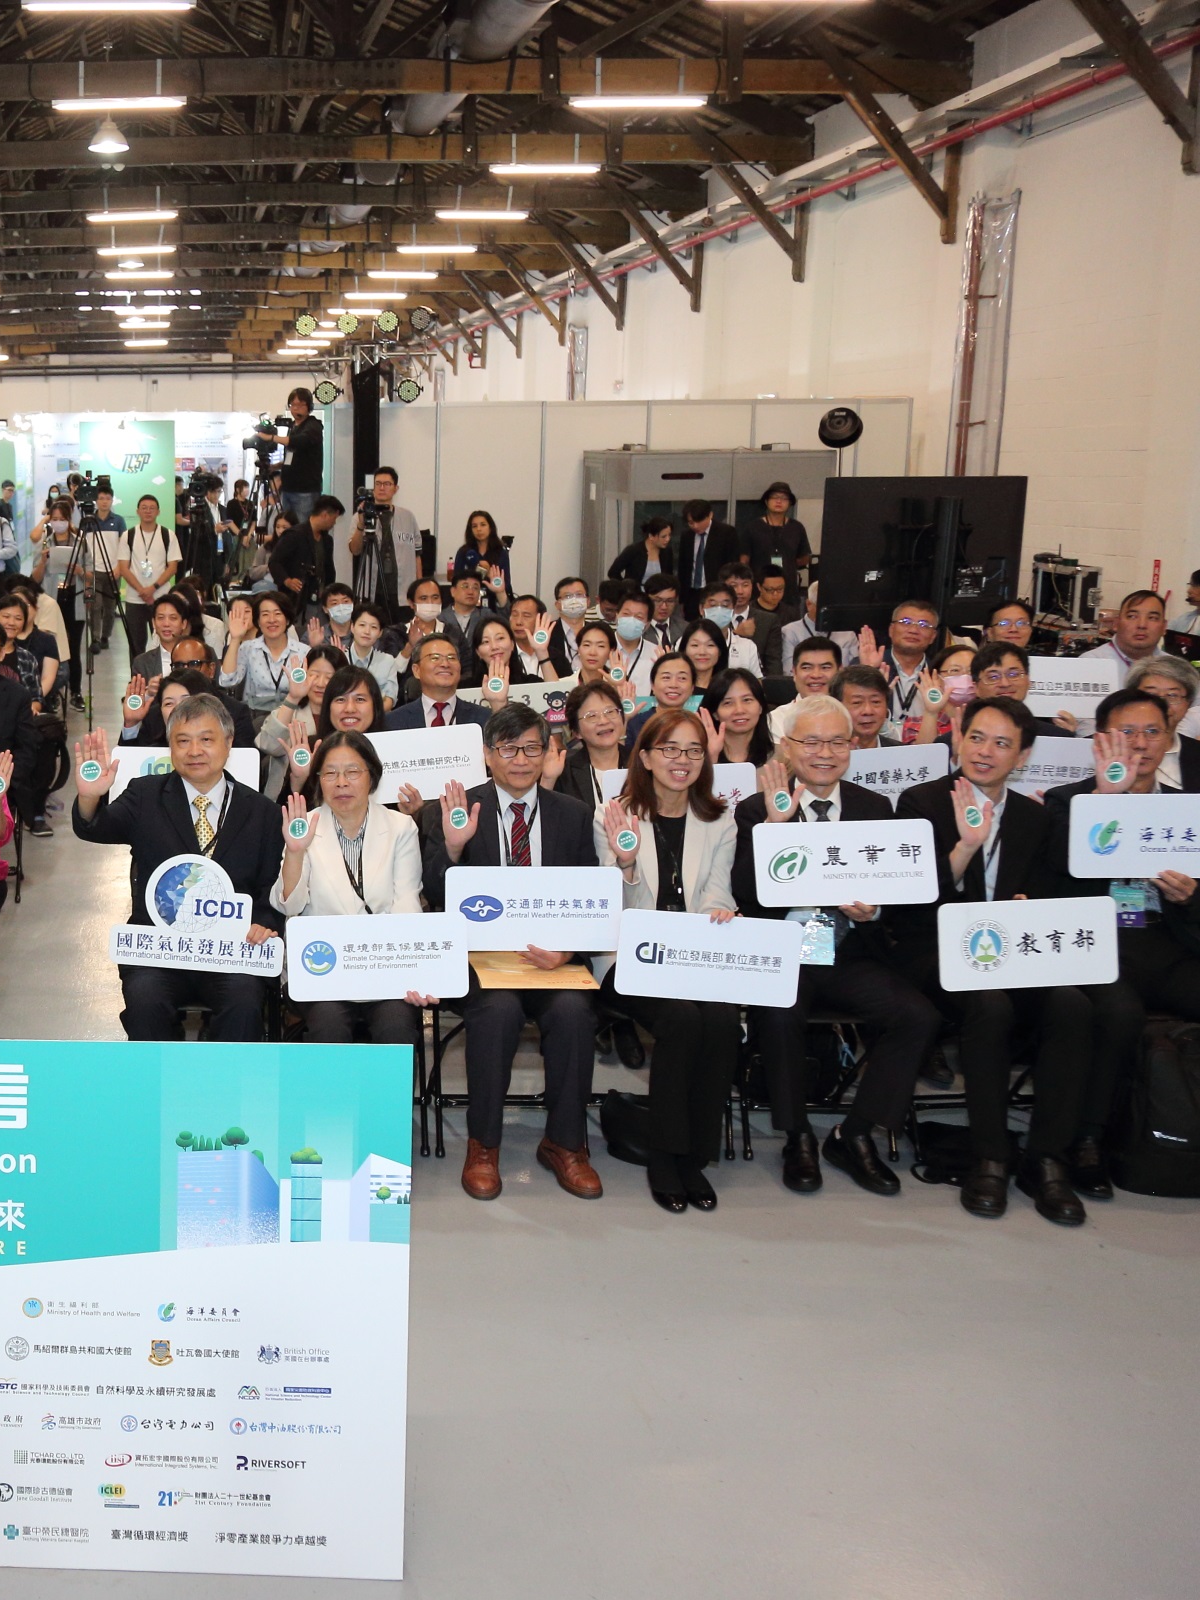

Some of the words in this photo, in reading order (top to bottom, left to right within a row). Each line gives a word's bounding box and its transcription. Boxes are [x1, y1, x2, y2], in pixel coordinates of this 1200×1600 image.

[852, 766, 930, 785] 中國醫藥大學
[822, 843, 922, 867] 農業部
[822, 872, 856, 880] MINISTRY
[871, 870, 925, 879] AGRICULTURE
[194, 898, 244, 920] ICDI
[506, 898, 610, 911] 交通部中央氣象署
[506, 911, 531, 920] Central
[531, 911, 560, 920] Weather
[560, 911, 610, 920] Administration
[116, 932, 276, 960] 國際氣候發展智庫
[343, 940, 455, 954] 環境部氣候變遷署
[1016, 928, 1096, 956] 教育部
[116, 949, 163, 962] International
[163, 953, 189, 964] Climate
[190, 955, 244, 968] Development
[244, 958, 276, 970] Institute
[343, 954, 368, 963] Climate
[369, 954, 393, 964] Change
[395, 953, 442, 962] Administration
[343, 963, 368, 973] Ministry
[378, 962, 419, 970] Environment
[47, 1309, 72, 1317] Ministry
[185, 1306, 241, 1318] 海洋委員會
[32, 1344, 133, 1356] 馬紹爾群島共和國大使館
[176, 1347, 241, 1359] 吐瓦魯國大使館
[284, 1347, 307, 1355] British
[308, 1347, 330, 1356] Office
[20, 1383, 91, 1393] 國家科學及技術委員會
[95, 1384, 217, 1398] 自然科學及永續研究發展處
[58, 1416, 102, 1426] 高雄市政府
[140, 1418, 215, 1431] 台灣電力公司
[251, 1459, 307, 1470] RIVERSOFT
[16, 1485, 73, 1496] 國際珍古德協會
[100, 1487, 122, 1495] ICLEI
[194, 1491, 271, 1502] 財團法人二十一世紀基金會
[22, 1525, 90, 1538] 臺中榮民總醫院
[110, 1529, 189, 1543] 臺灣循環經濟獎
[214, 1532, 328, 1547] 淨零產業競爭力卓越獎
